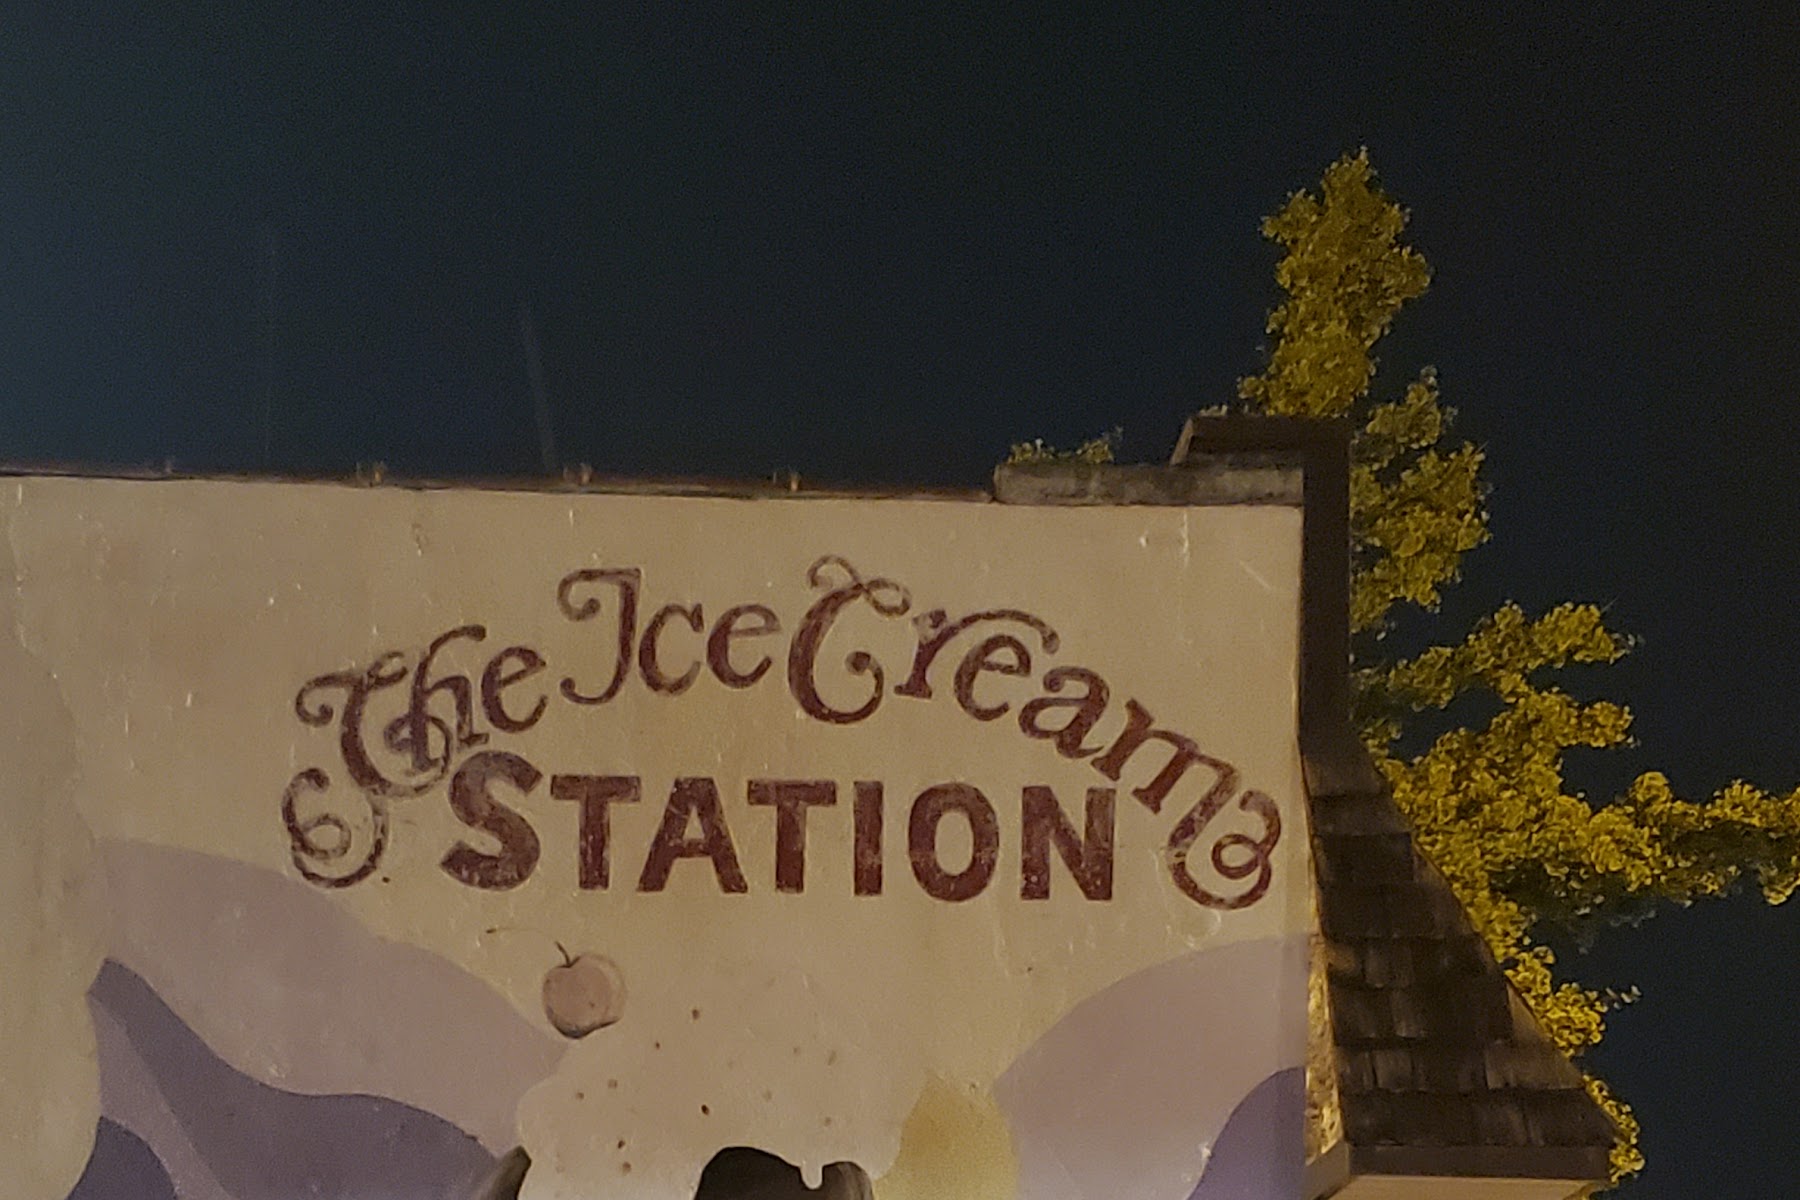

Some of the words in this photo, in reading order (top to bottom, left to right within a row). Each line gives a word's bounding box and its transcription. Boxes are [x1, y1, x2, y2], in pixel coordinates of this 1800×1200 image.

[282, 623, 548, 888] The
[557, 567, 782, 706] Ice
[787, 555, 1282, 910] Cream
[439, 750, 1117, 903] STATION
